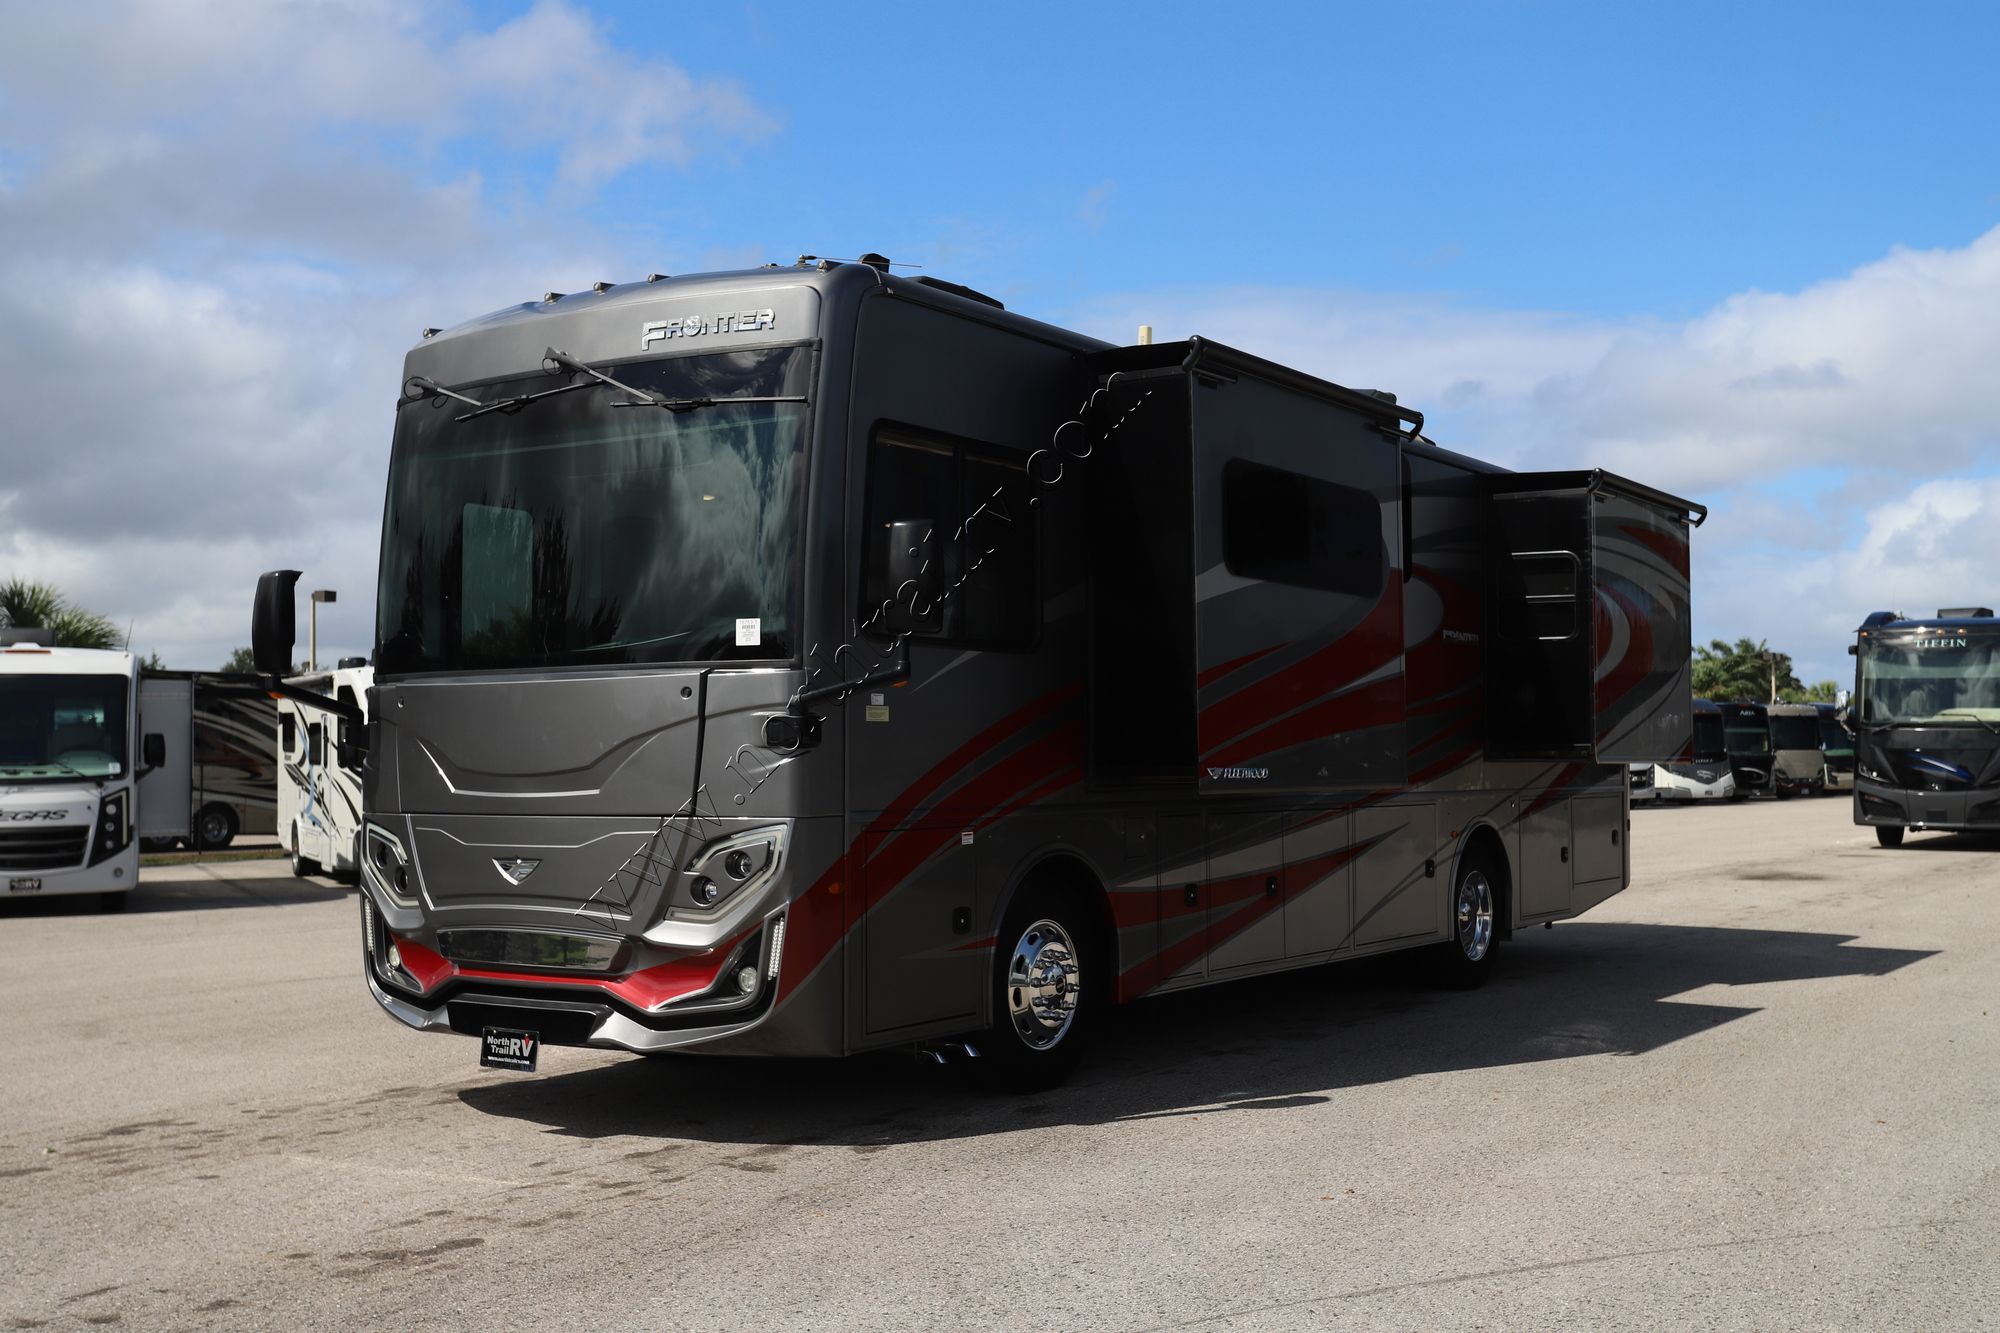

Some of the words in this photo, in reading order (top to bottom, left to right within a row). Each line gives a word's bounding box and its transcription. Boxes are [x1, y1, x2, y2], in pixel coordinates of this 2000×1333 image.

[641, 308, 775, 351] FRONTIER
[1914, 638, 1967, 648] TIFFIN
[0, 809, 69, 821] EGAS
[487, 1035, 510, 1046] North
[490, 1044, 509, 1055] Trail
[509, 1038, 534, 1057] RV
